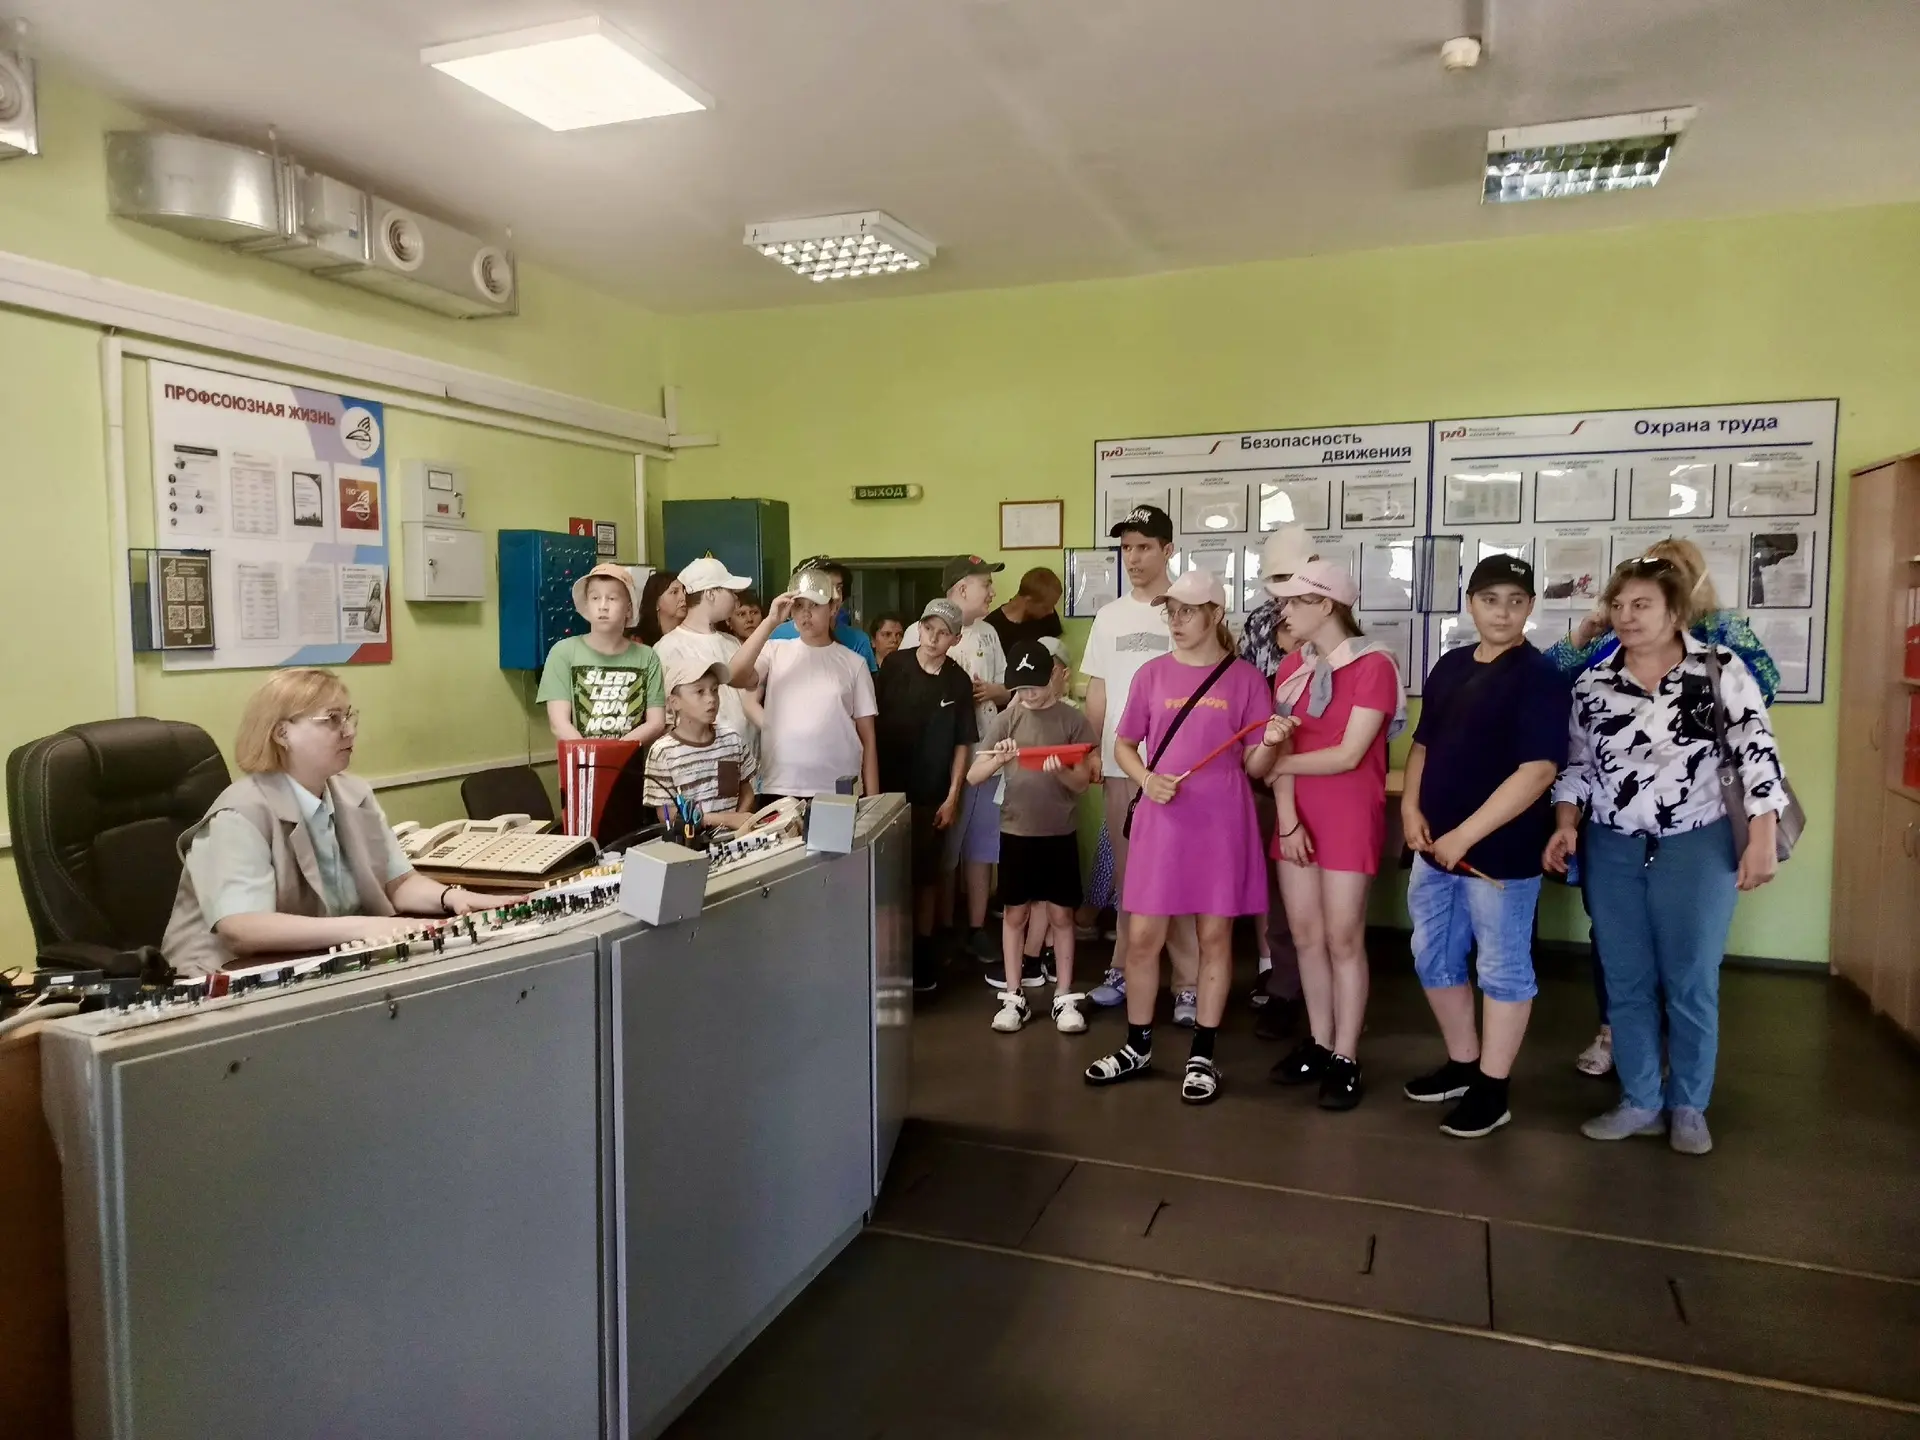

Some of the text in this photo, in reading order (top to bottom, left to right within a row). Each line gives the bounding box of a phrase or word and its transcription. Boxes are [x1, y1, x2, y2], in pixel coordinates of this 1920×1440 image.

[164, 383, 336, 427] ПРОФСОЮЗНАЯ ЖИЗНЬ
[1634, 416, 1778, 437] Охрана труда
[1240, 432, 1362, 450] Безопасность
[1322, 445, 1412, 463] движения
[859, 486, 904, 498] ВЫХОД
[584, 671, 637, 686] SLEEP
[590, 685, 630, 701] LESS
[591, 700, 629, 716] RUN
[585, 716, 634, 732] MORE
